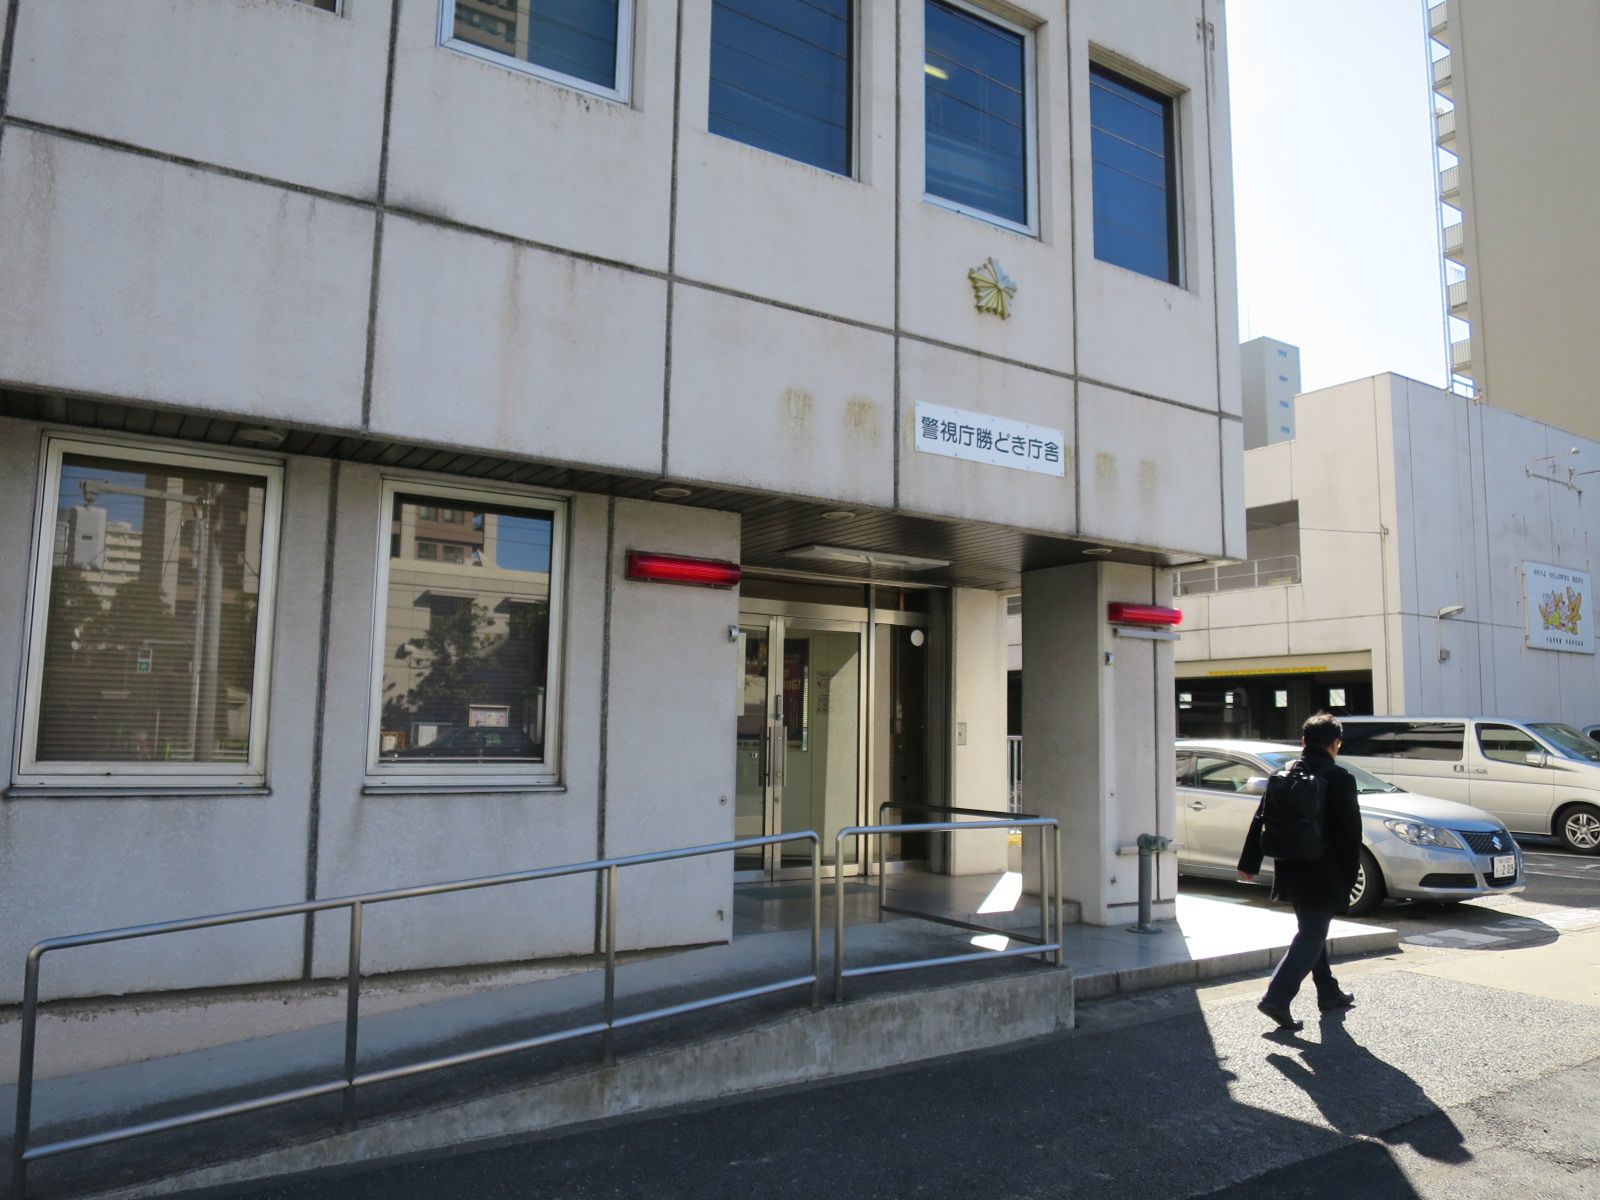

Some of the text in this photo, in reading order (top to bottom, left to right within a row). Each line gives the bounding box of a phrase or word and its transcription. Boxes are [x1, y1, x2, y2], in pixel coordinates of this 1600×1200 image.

[921, 416, 1059, 463] 警視庁勝どき庁舎
